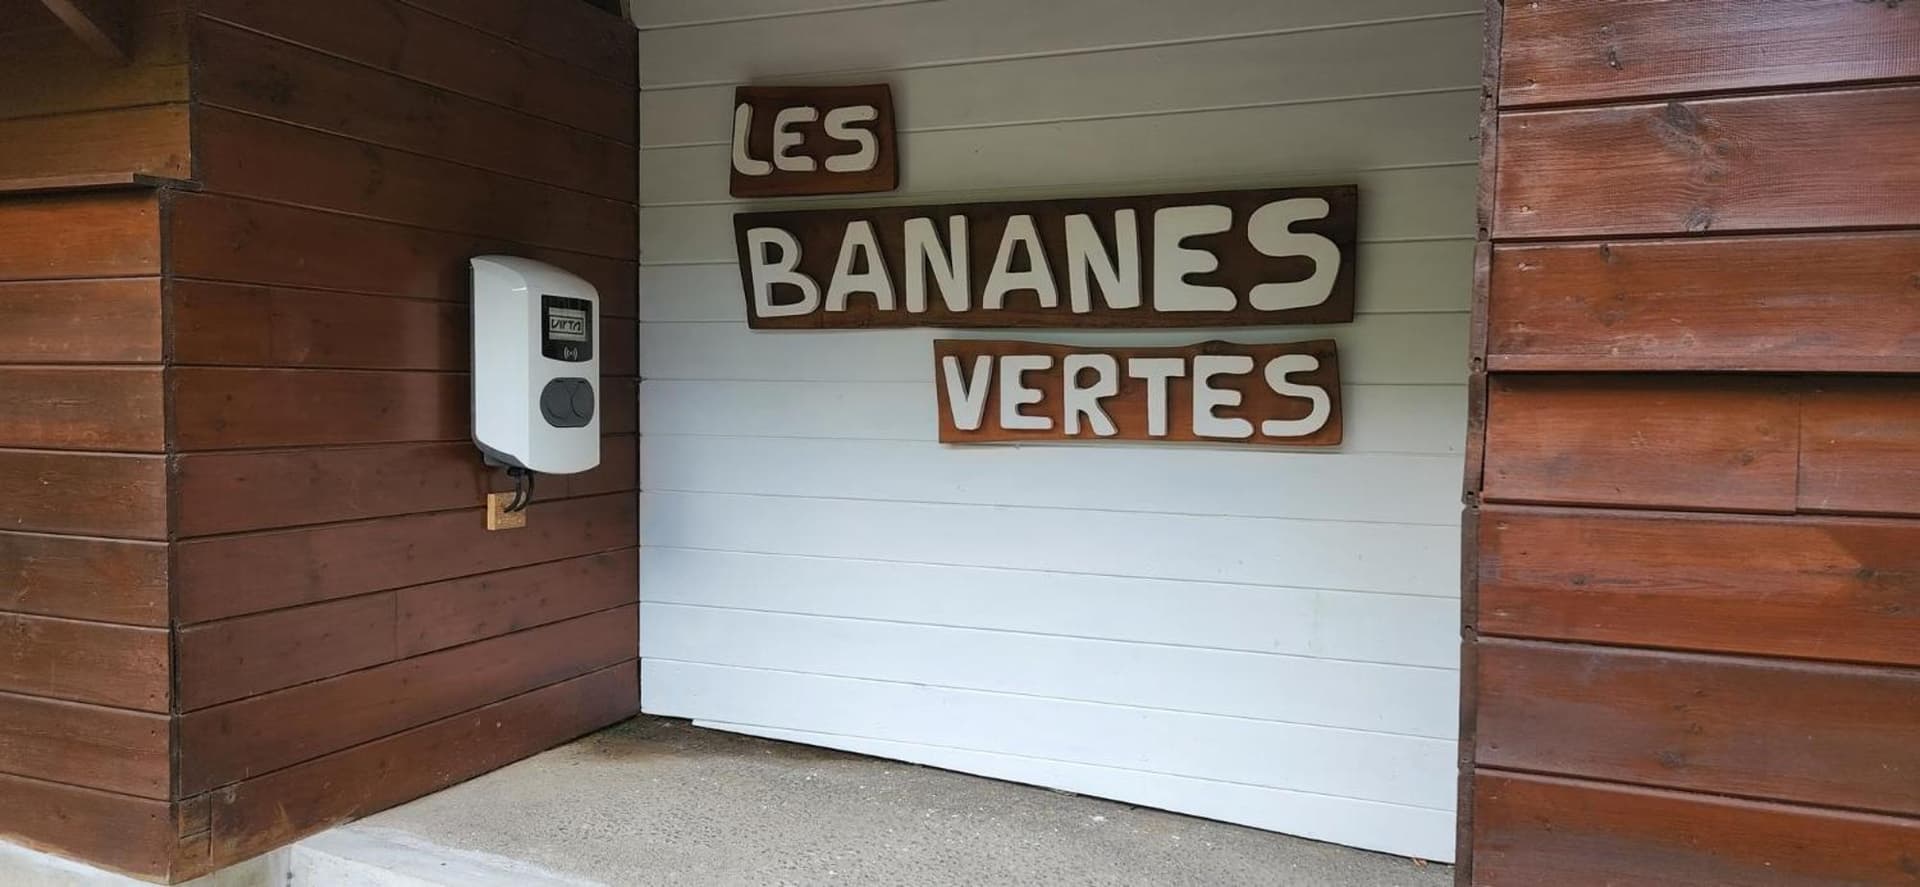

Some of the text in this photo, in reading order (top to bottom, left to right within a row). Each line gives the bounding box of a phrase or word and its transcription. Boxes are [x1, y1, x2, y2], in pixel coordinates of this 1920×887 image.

[733, 103, 879, 175] LES
[747, 198, 1341, 318] BANANES
[943, 354, 1332, 437] VERTES
